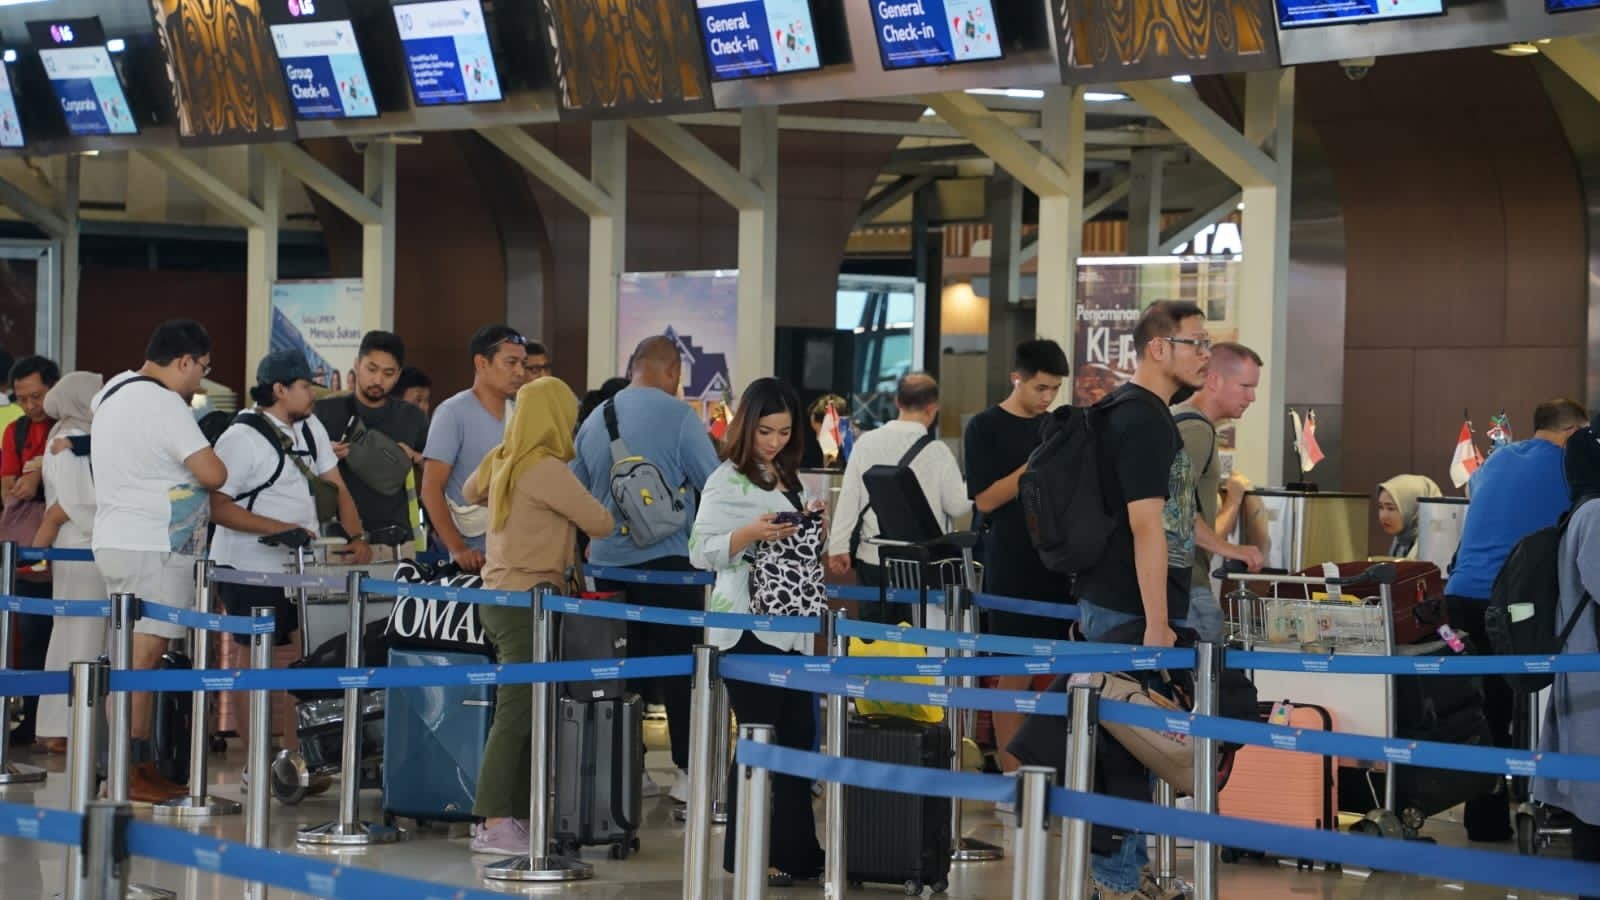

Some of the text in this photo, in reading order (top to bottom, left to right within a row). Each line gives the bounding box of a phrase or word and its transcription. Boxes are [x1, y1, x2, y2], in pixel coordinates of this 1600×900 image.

[879, 0, 925, 19] General
[706, 11, 750, 33] General
[883, 22, 934, 42] Check-in
[711, 35, 759, 56] Check-in
[286, 65, 314, 83] Group
[292, 83, 330, 99] Check-in
[1171, 223, 1242, 254] TA
[1076, 303, 1140, 325] Penjaminan
[384, 594, 485, 645] OMA
